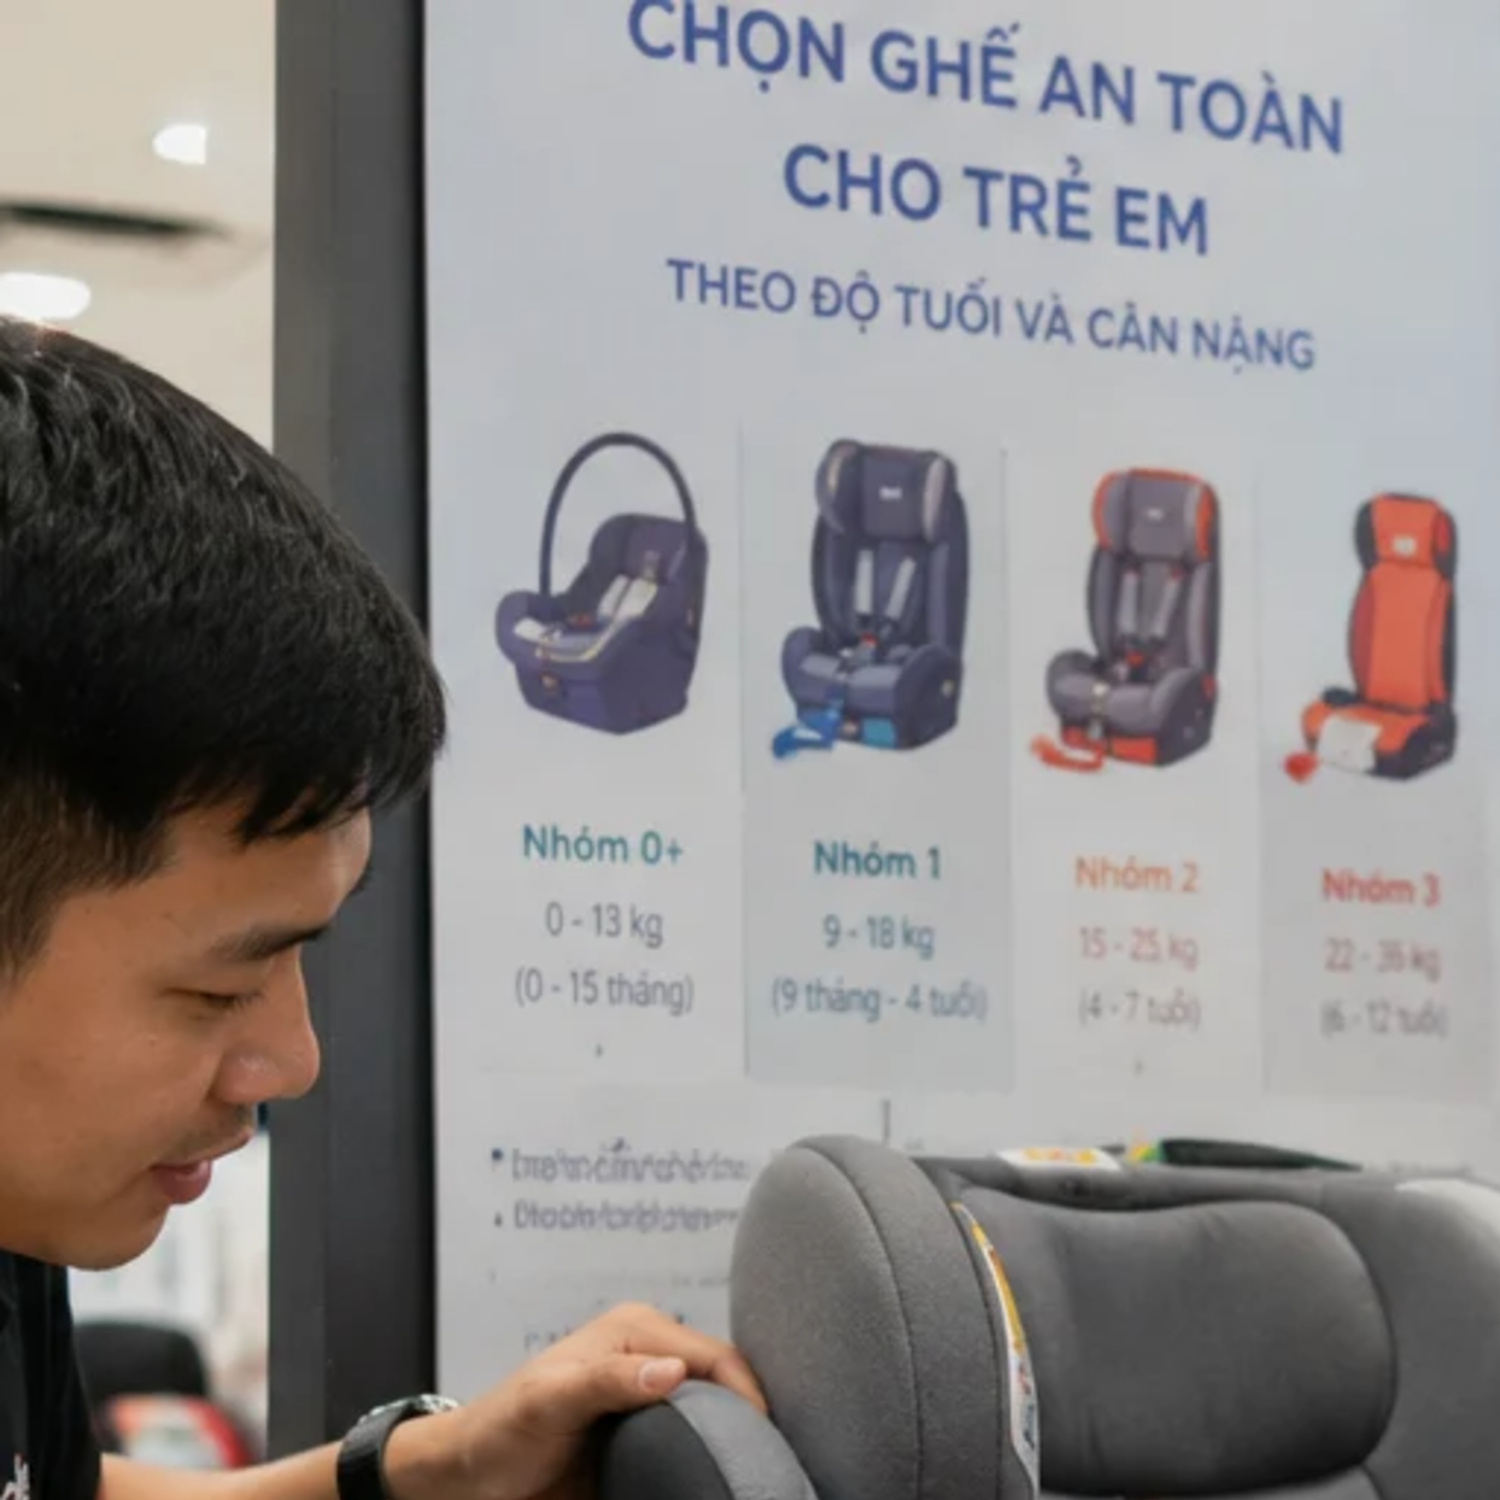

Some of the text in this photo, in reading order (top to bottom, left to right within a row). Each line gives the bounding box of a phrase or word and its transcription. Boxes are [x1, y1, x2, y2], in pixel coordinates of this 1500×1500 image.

[628, 0, 1342, 155] CHỌN GHẾ AN TOÀN
[784, 144, 1208, 256] CHO TRẺ EM
[666, 258, 797, 313] THEO
[811, 269, 881, 334] ĐỘ
[1014, 291, 1074, 344] VÀ
[522, 824, 684, 864] Nhóm 0+
[813, 840, 942, 879] Nhóm 1
[1076, 856, 1199, 893] Nhóm 2
[545, 901, 563, 937] 0
[592, 902, 622, 937] 13
[630, 903, 663, 950] kg
[823, 913, 841, 948] 9
[867, 915, 895, 949] 18
[902, 914, 935, 961] kg
[570, 970, 599, 1005] 15
